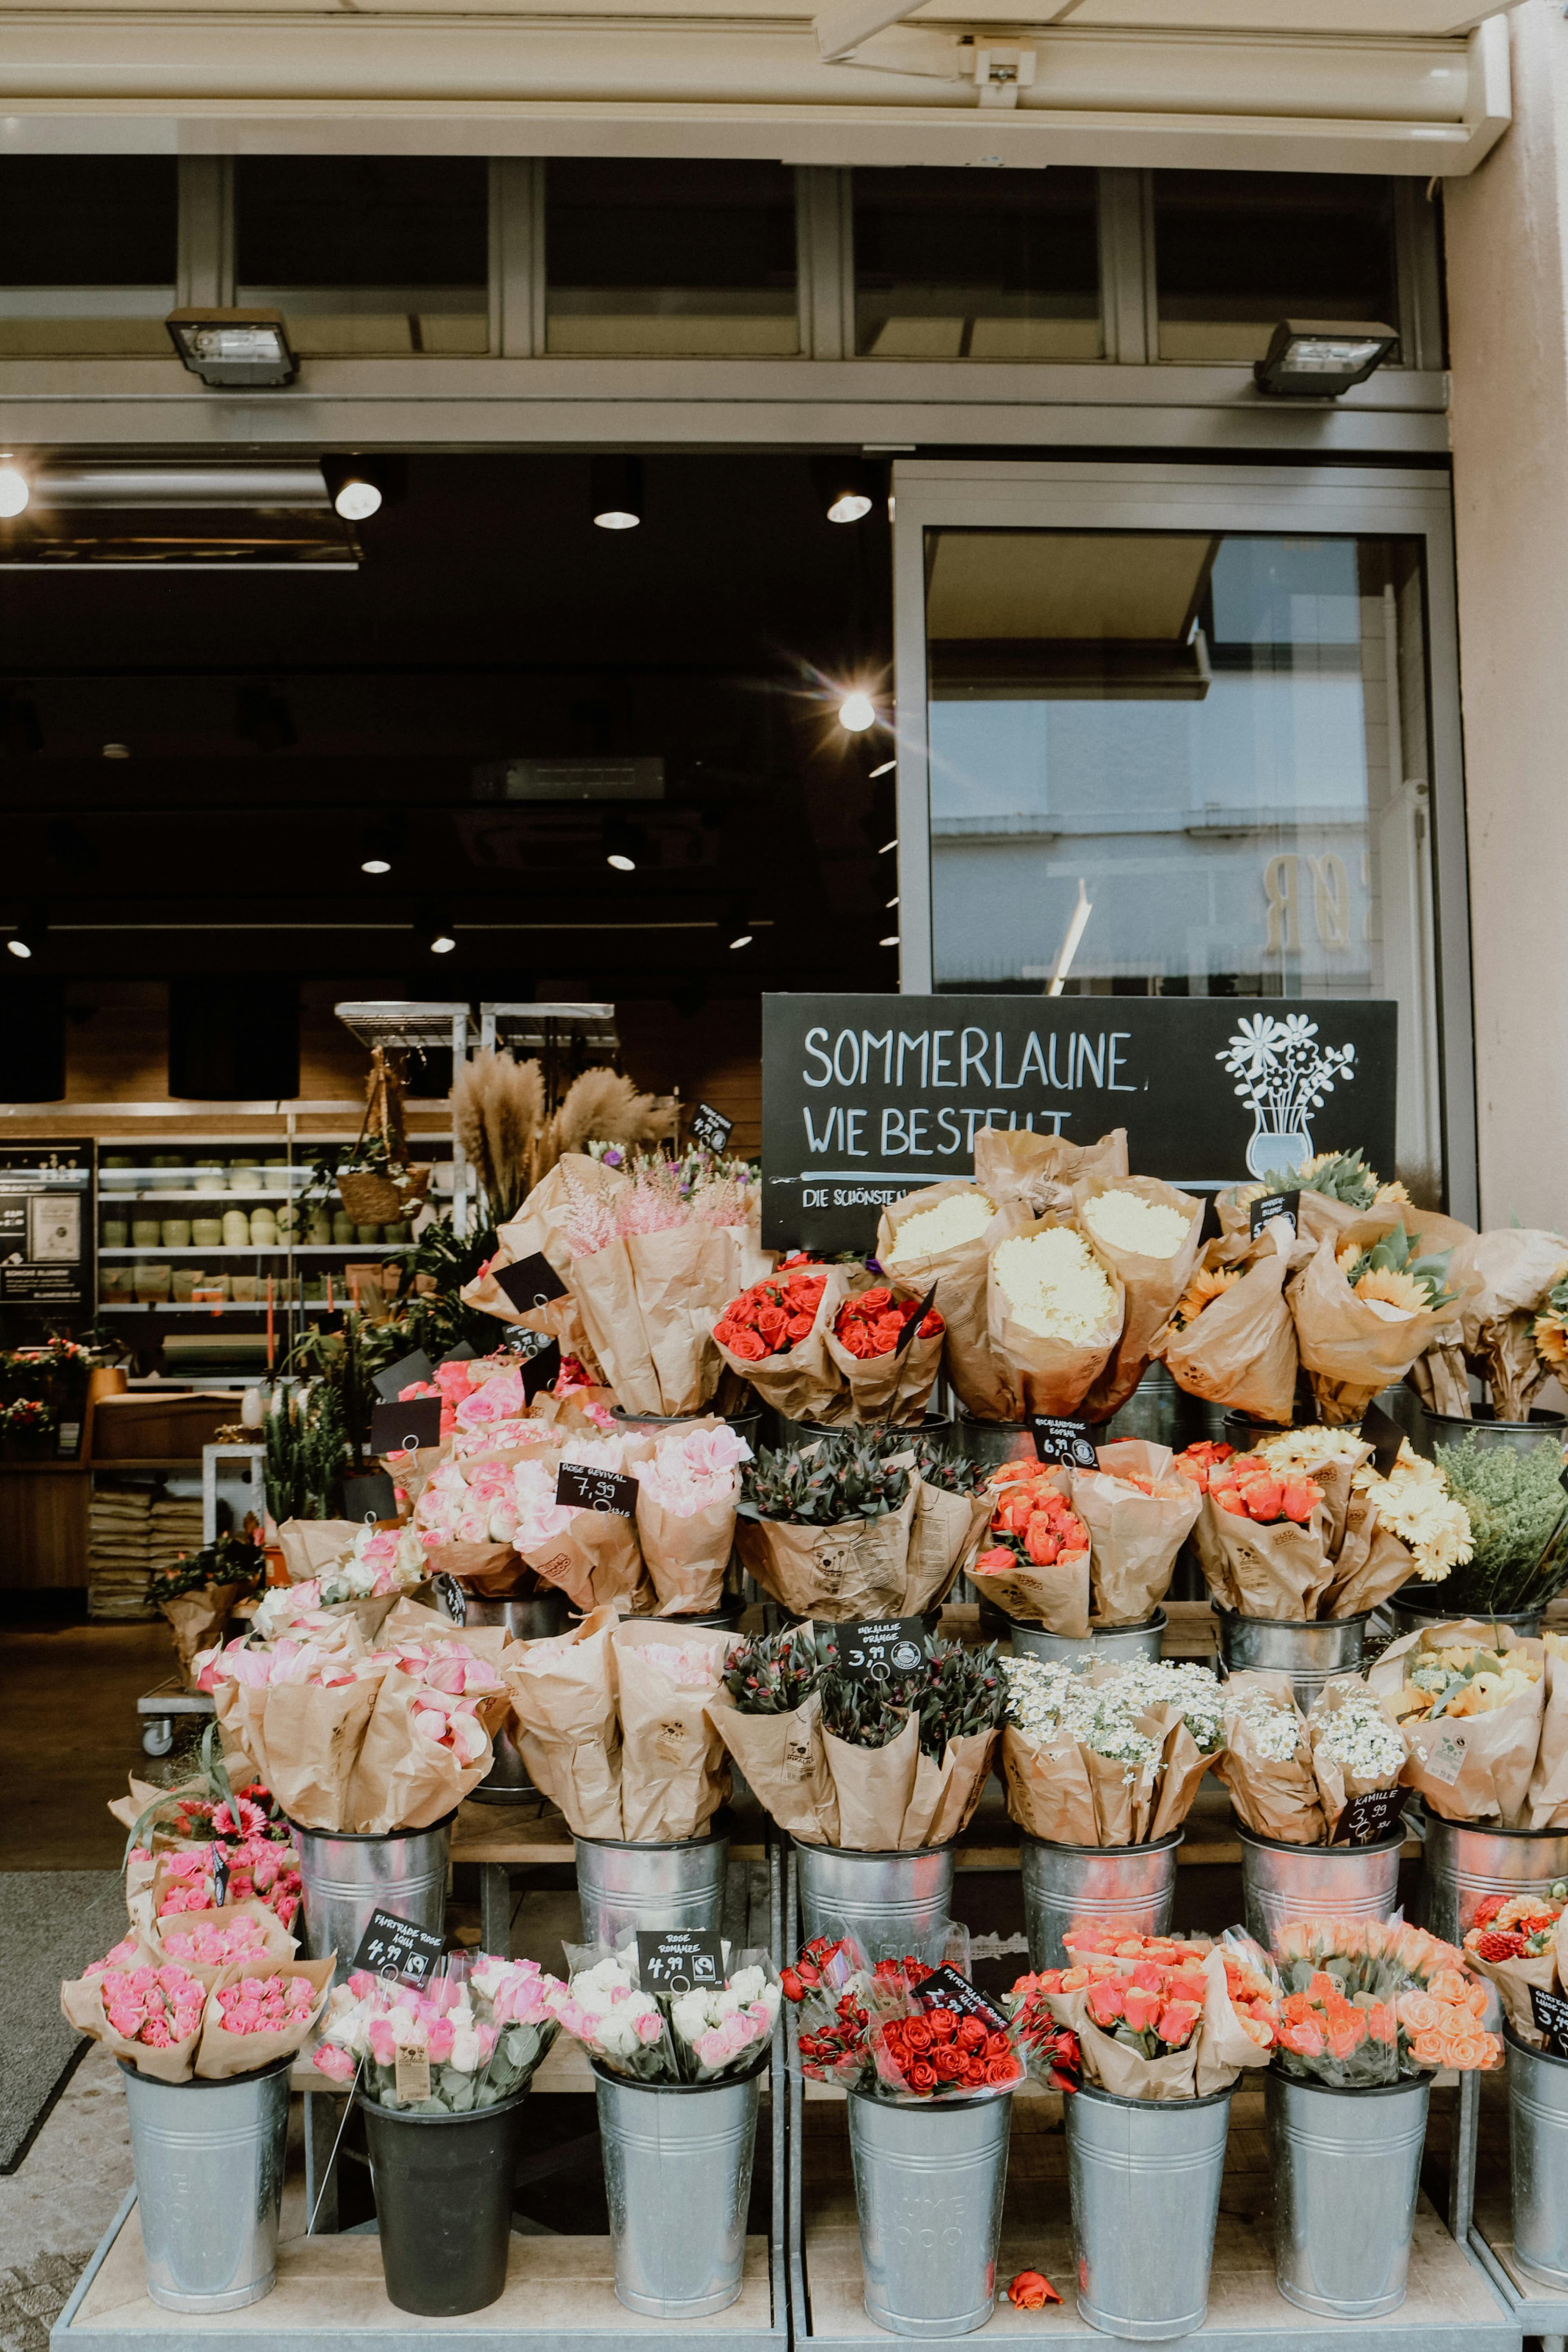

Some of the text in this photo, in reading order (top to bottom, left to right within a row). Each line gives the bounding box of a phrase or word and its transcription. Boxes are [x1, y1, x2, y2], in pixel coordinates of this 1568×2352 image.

[803, 1107, 868, 1156] WIE
[803, 1189, 829, 1207] DIE
[1044, 1438, 1068, 1457] 6,99
[562, 1463, 627, 1483] ROSE REVIVAL
[862, 1633, 899, 1644] ORANGE
[848, 1646, 886, 1668] 3,99
[1354, 1790, 1399, 1806] KAMILLE
[374, 1914, 442, 1946] FAIRTRADE ROSE
[665, 1934, 691, 1943] ROSE
[392, 1933, 414, 1949] AQUA
[658, 1944, 701, 1954] ROMANZE
[368, 1939, 402, 1965] 4,99
[647, 1956, 684, 1980] 4,99
[944, 1968, 1008, 2027] FAIRTRADE ROSE
[959, 1993, 978, 2013] NALA
